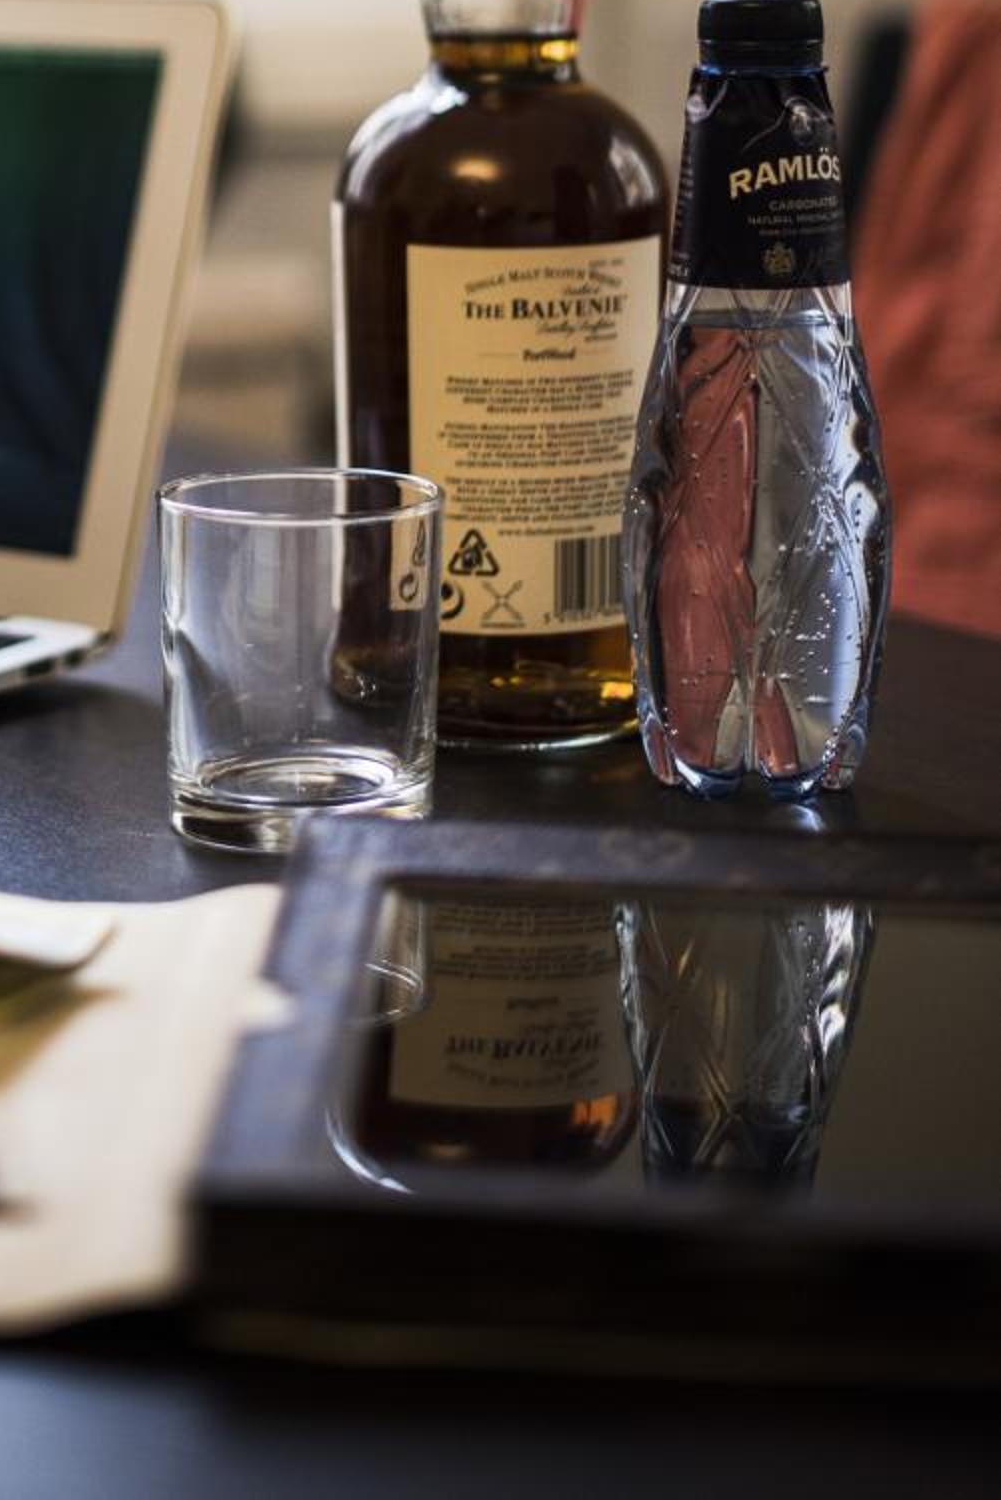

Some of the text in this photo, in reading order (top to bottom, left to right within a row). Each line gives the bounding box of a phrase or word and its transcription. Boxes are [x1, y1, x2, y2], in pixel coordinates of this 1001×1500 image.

[508, 268, 540, 282] MALT
[464, 295, 623, 320] THE BALVENIE
